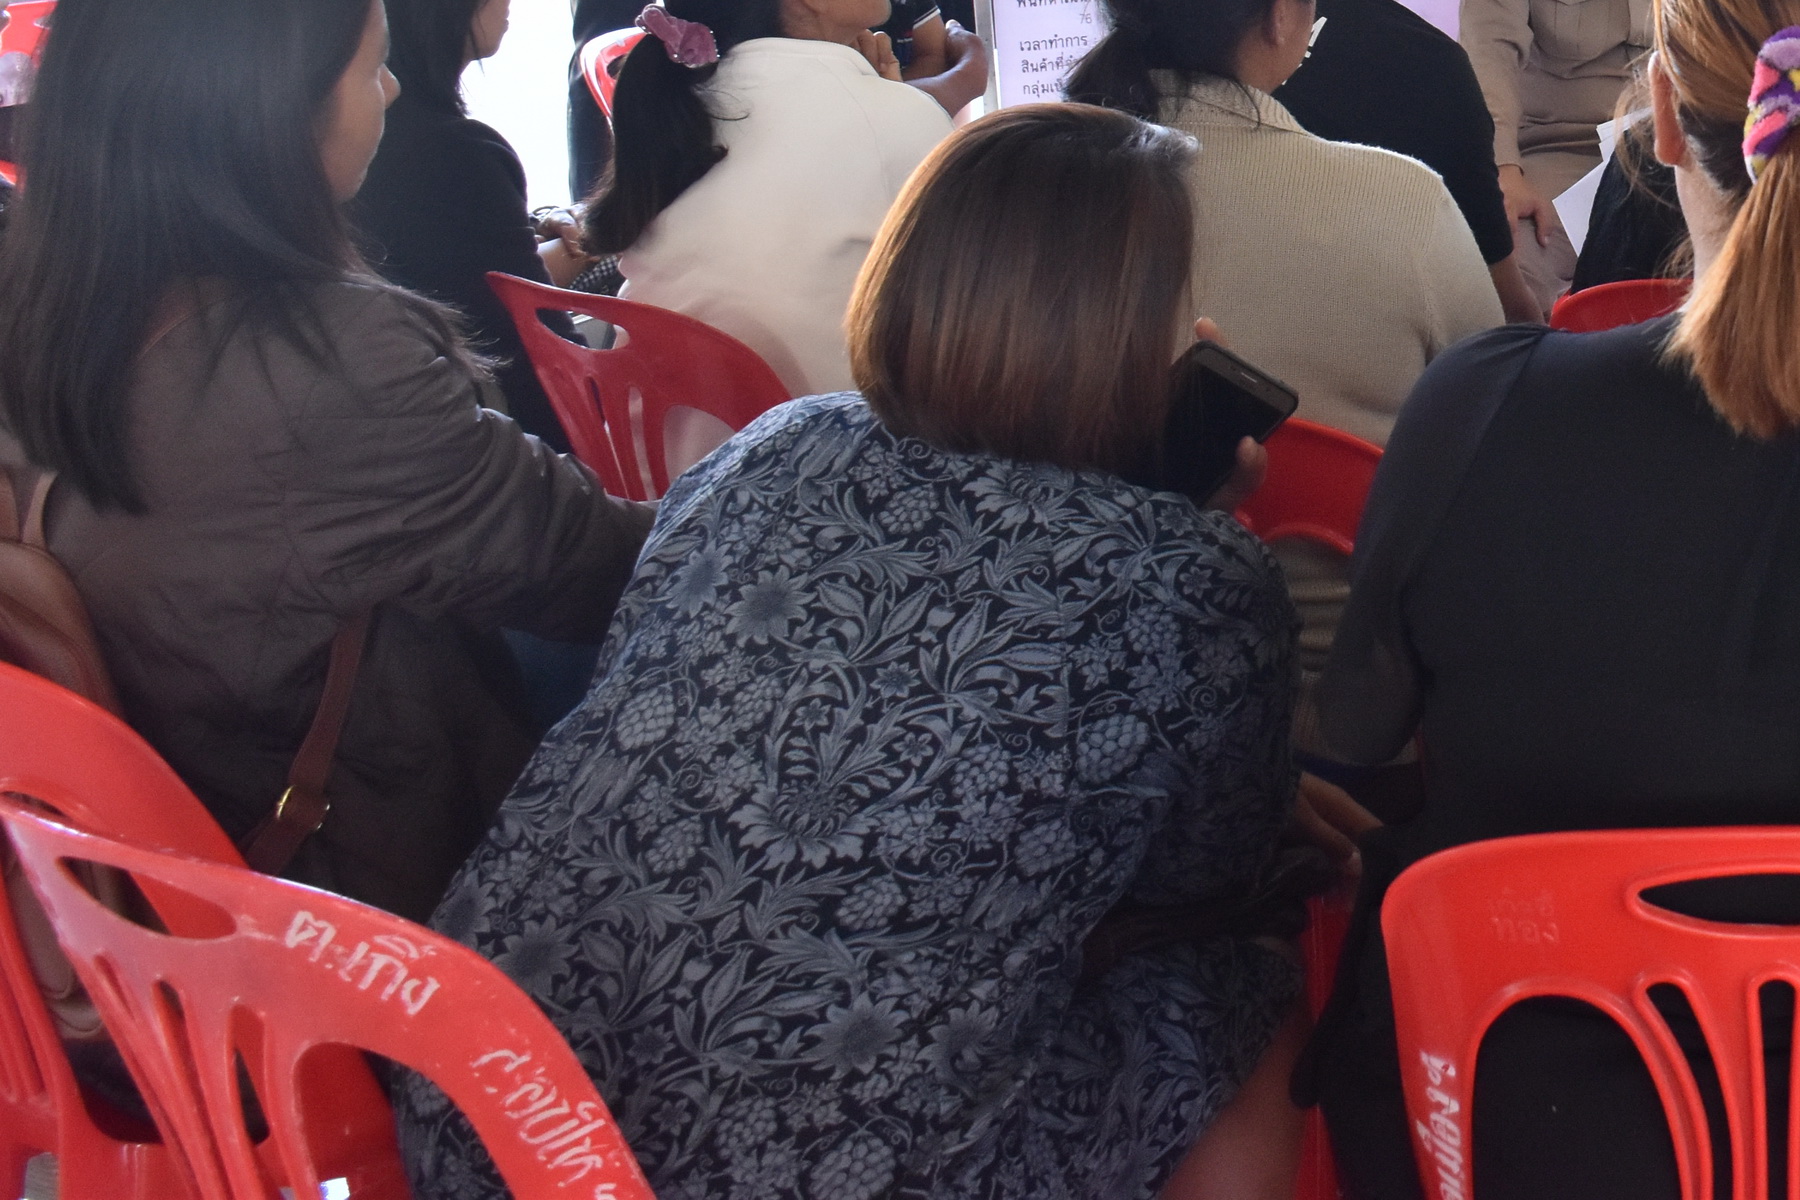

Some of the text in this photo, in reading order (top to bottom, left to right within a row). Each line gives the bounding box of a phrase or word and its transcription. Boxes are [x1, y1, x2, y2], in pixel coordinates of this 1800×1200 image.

[1079, 13, 1093, 25] 76
[1020, 34, 1088, 51] เวลาทำการ
